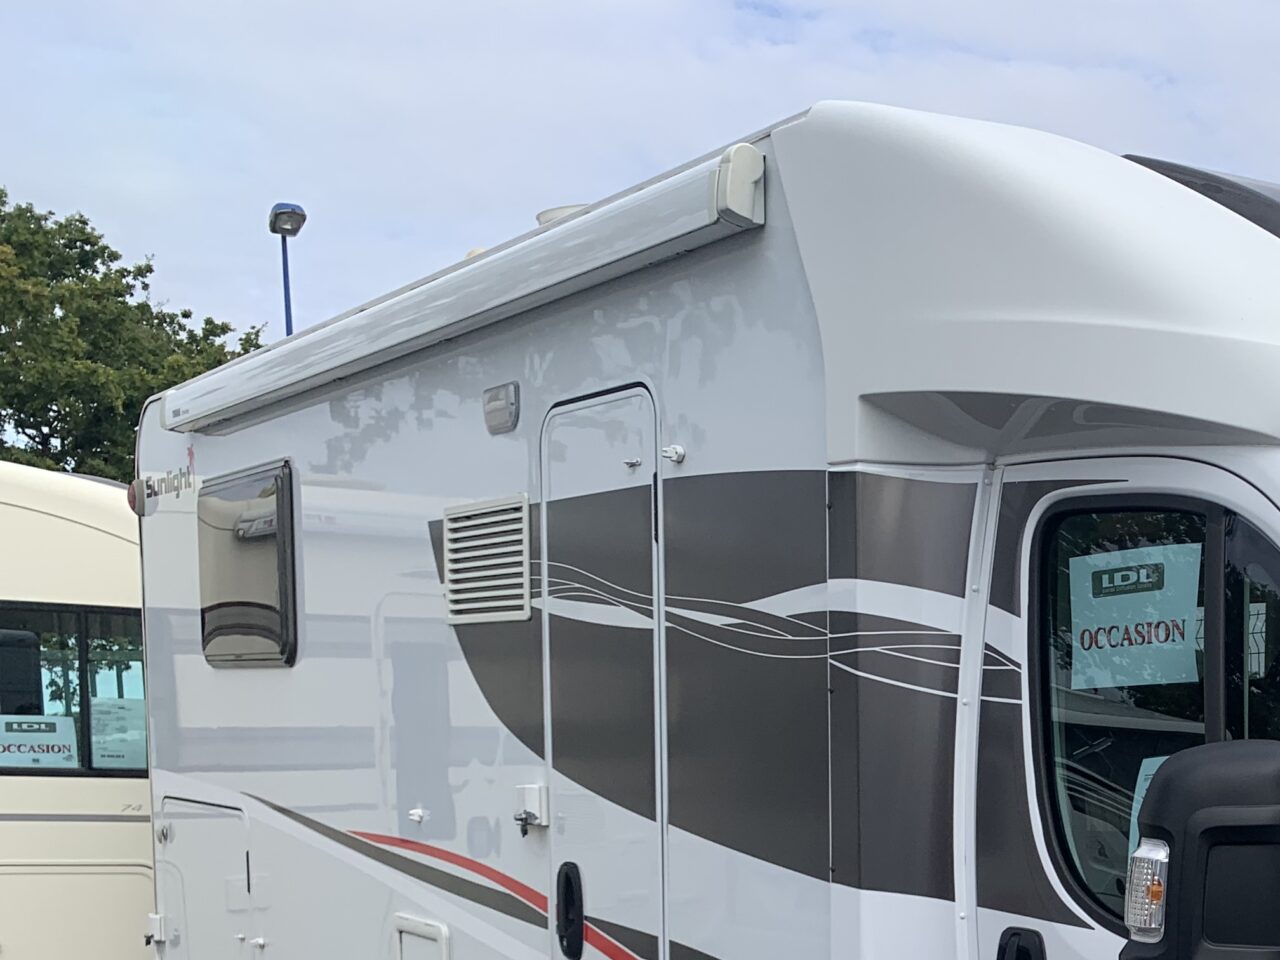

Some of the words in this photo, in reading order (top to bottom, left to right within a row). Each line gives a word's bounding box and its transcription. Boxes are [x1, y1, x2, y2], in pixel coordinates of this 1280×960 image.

[145, 465, 192, 499] Sunlight
[1101, 568, 1153, 589] LDL
[1079, 618, 1186, 651] OCCASION
